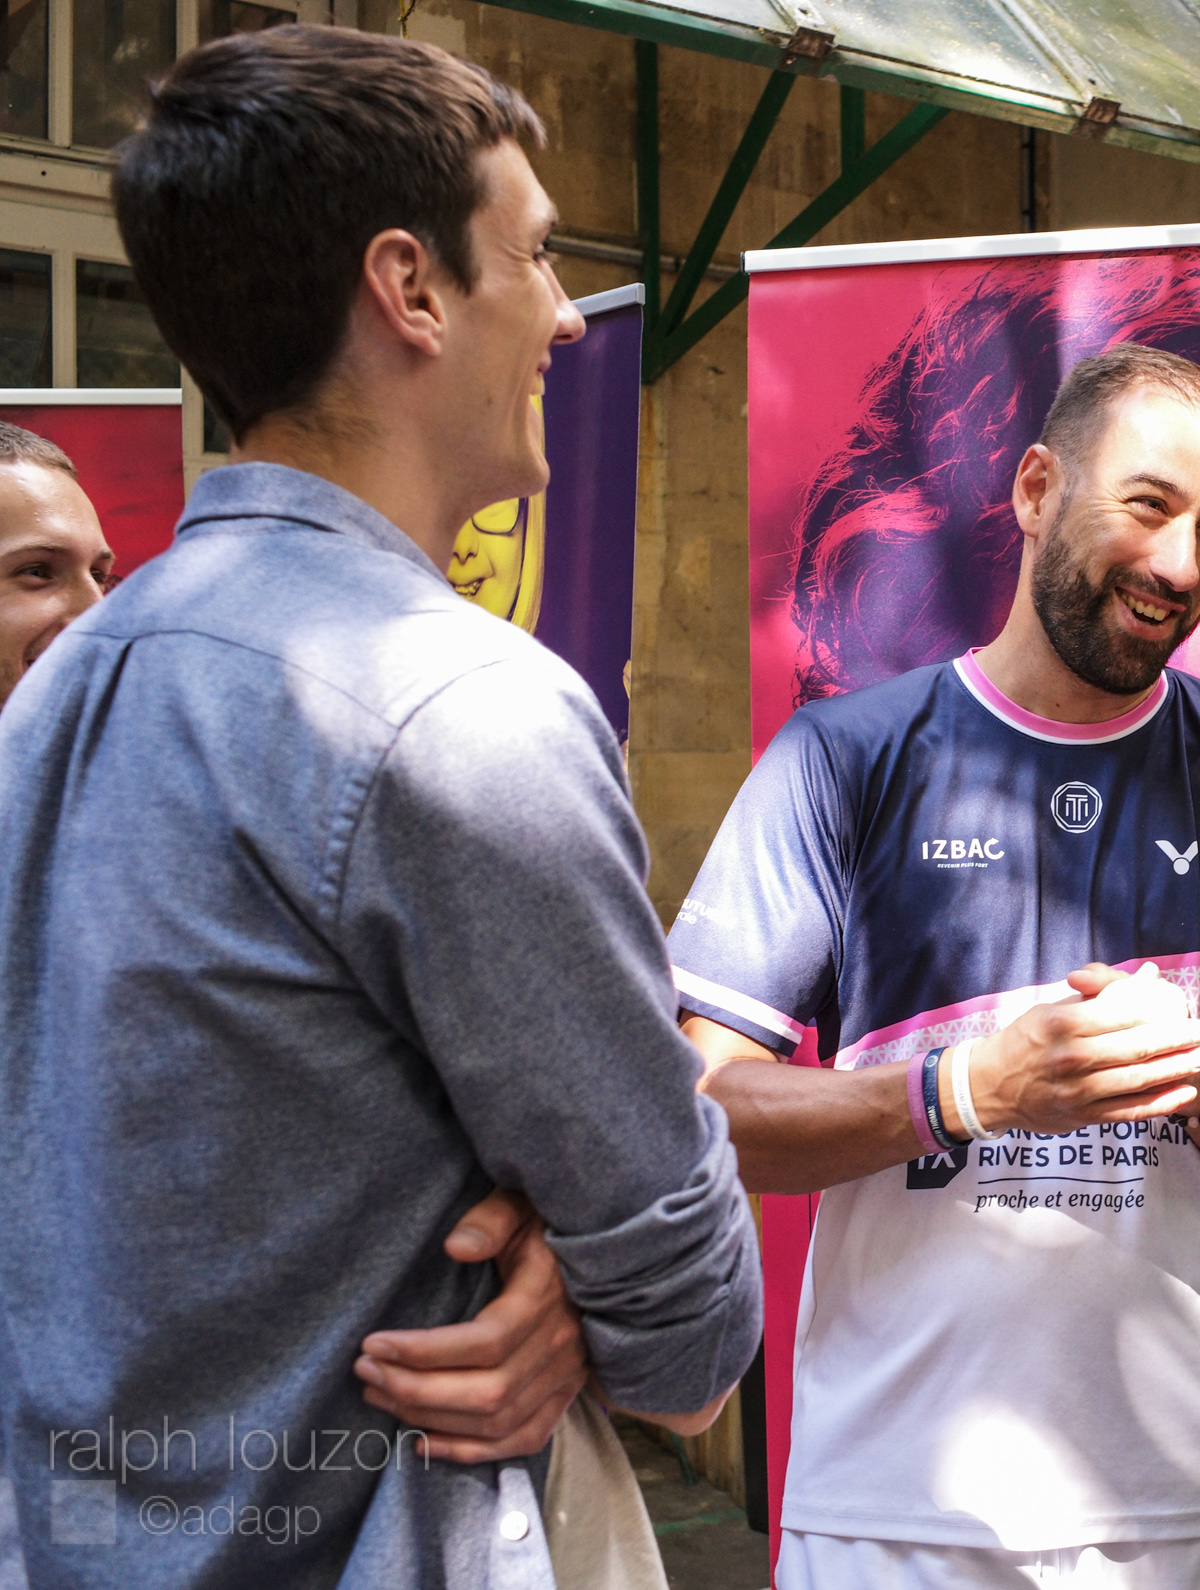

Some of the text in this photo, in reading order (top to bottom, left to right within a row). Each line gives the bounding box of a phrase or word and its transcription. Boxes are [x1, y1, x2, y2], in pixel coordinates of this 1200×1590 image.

[922, 837, 1005, 860] IZBAC
[979, 1145, 1050, 1167] RIVES
[1059, 1145, 1093, 1165] DE
[1102, 1145, 1159, 1167] PARIS
[974, 1189, 1145, 1213] proche et engagée
